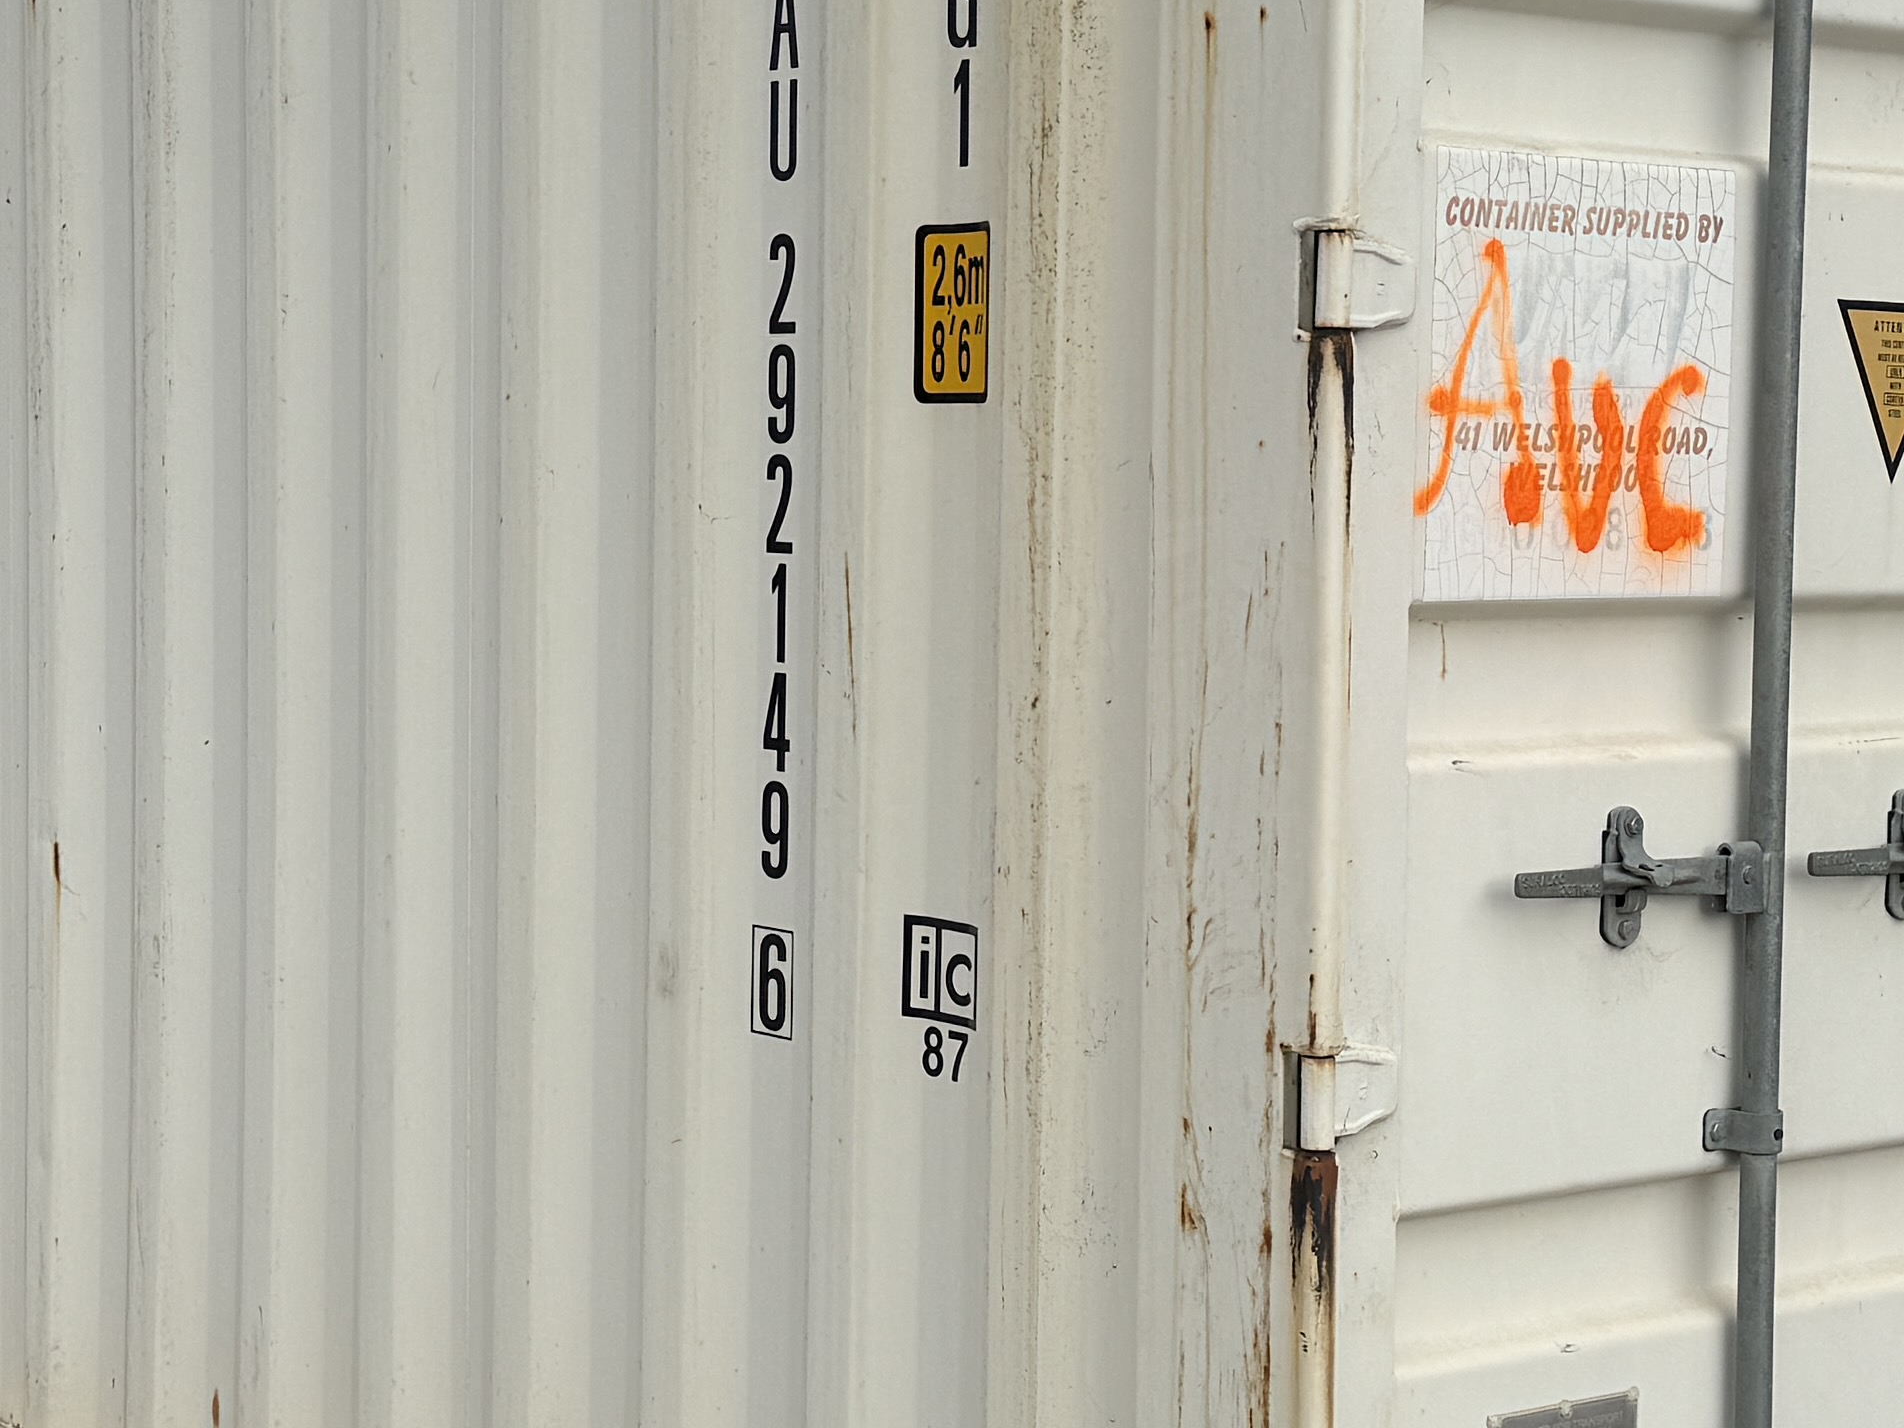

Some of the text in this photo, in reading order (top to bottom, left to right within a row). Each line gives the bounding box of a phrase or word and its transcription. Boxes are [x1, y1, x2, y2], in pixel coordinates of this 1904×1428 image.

[1445, 195, 1724, 244] CONTAINER SUPPLIED BY
[932, 243, 985, 316] 2,6m
[1454, 421, 1714, 461] 41 WELSHPOOL ROAD,
[760, 233, 797, 879] 292149
[756, 931, 789, 1035] 6
[921, 1026, 970, 1084] 87
